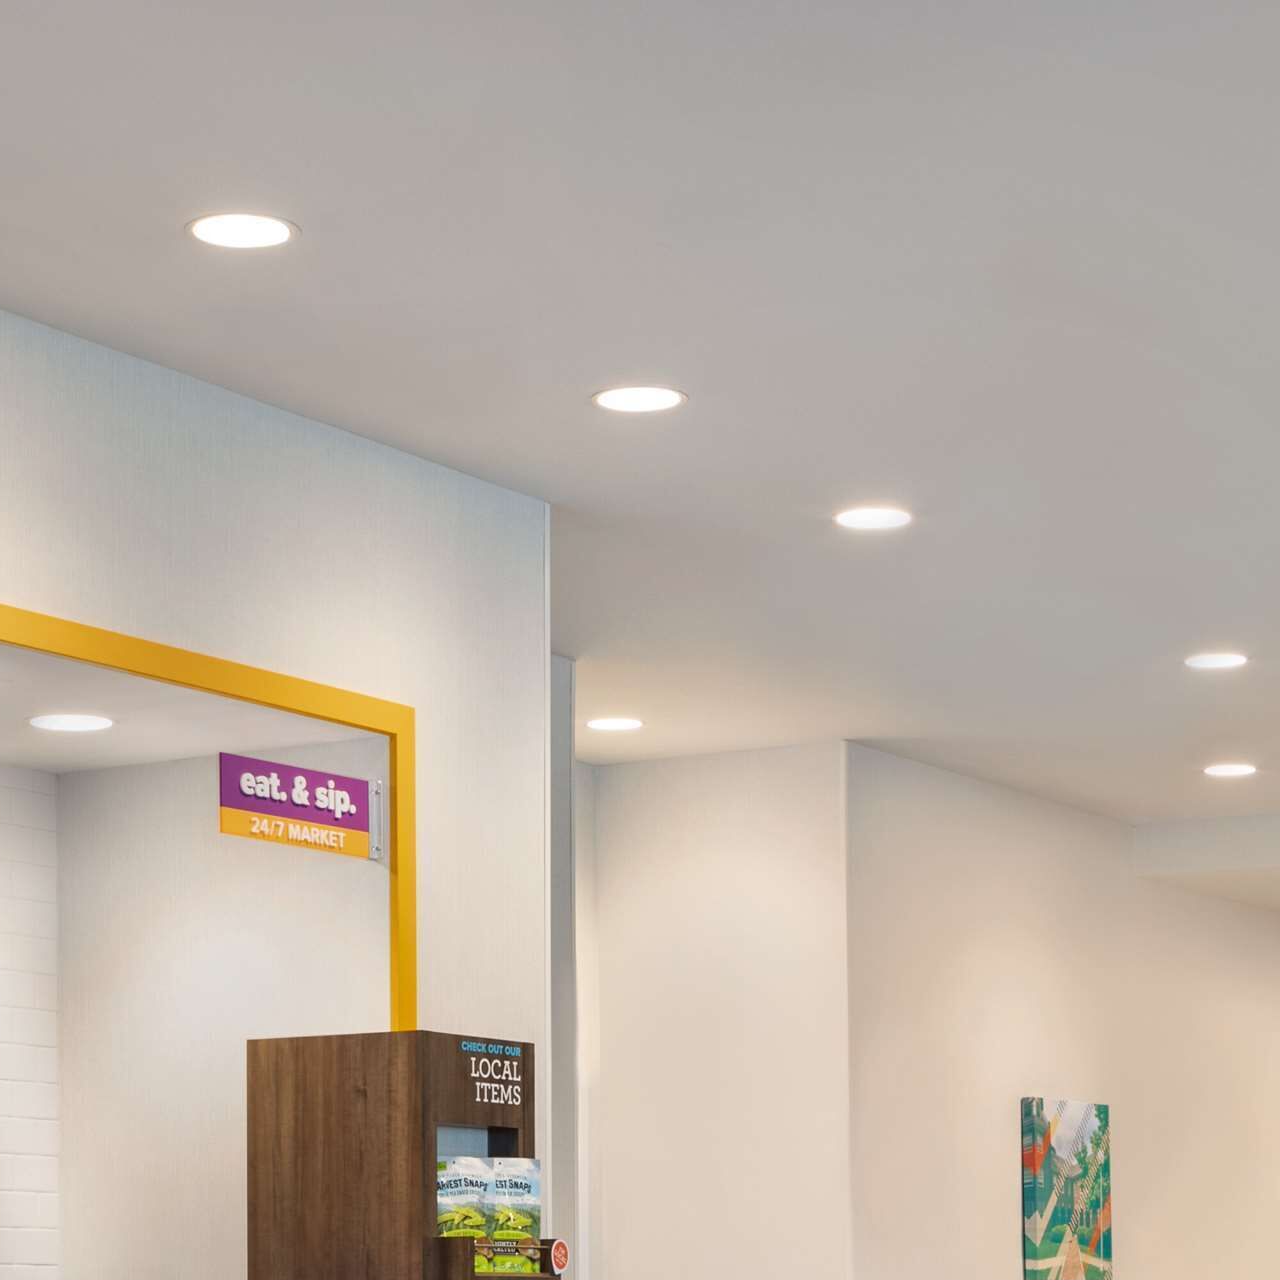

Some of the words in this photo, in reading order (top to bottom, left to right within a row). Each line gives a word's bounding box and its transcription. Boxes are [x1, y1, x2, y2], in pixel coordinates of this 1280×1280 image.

[240, 772, 287, 802] eat.
[292, 775, 310, 806] &
[315, 779, 357, 819] sip.
[251, 817, 286, 837] 24/7
[288, 822, 346, 848] MARKET
[461, 1041, 487, 1053] CHECK
[488, 1044, 504, 1055] OUT
[505, 1046, 521, 1057] OUR
[470, 1057, 521, 1081] LOCAL
[475, 1082, 521, 1105] ITEMS
[436, 1178, 463, 1191] ARVEST
